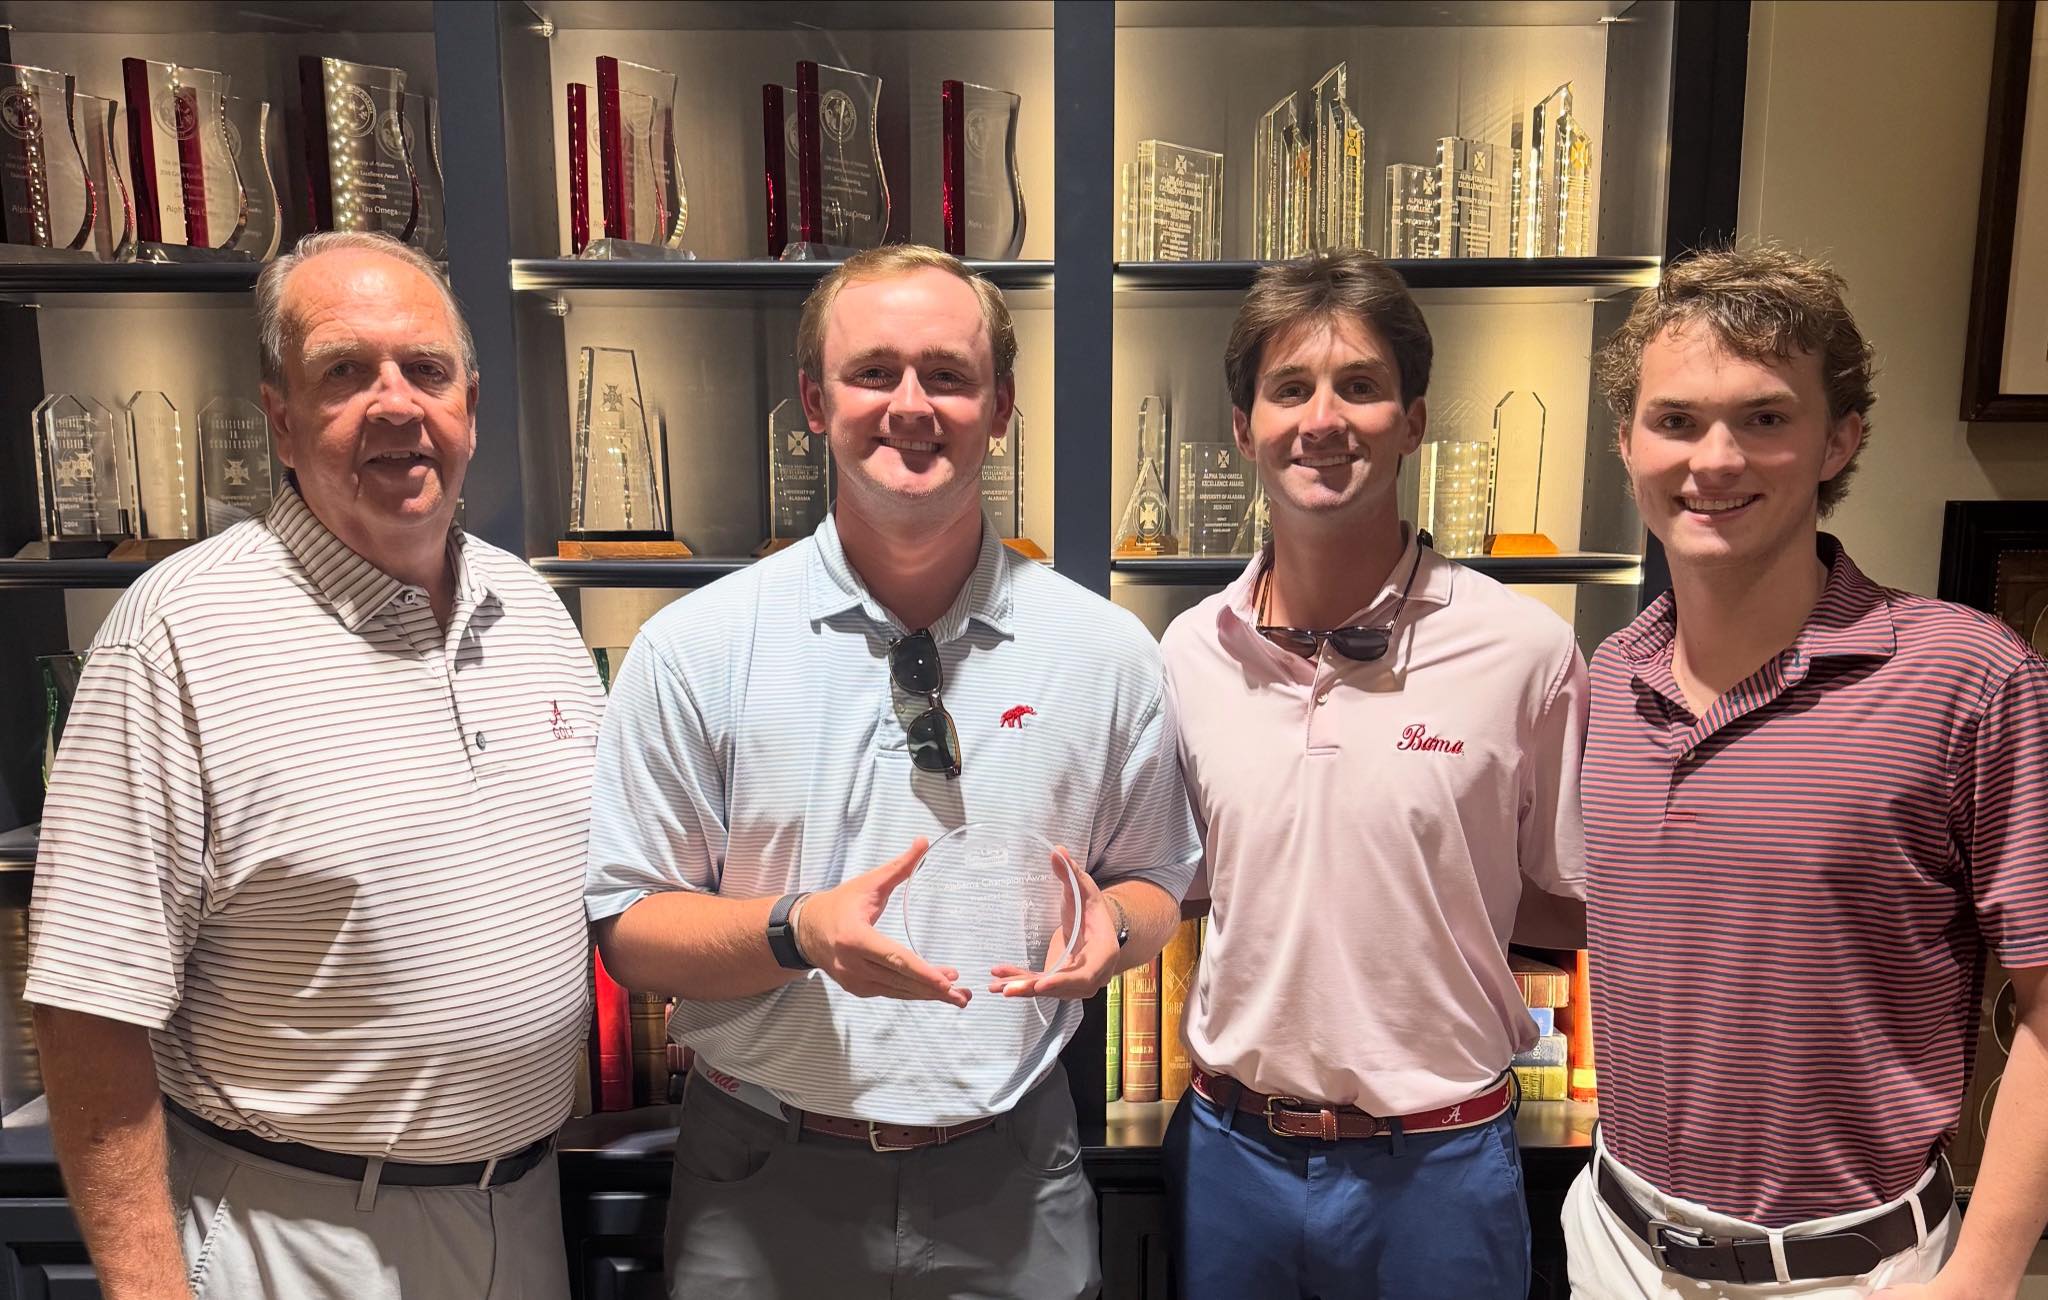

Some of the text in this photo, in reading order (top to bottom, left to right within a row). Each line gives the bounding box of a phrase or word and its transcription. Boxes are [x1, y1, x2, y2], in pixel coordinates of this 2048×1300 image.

[374, 206, 398, 216] Omega
[1397, 724, 1464, 754] Bama
[1442, 1105, 1462, 1124] A
